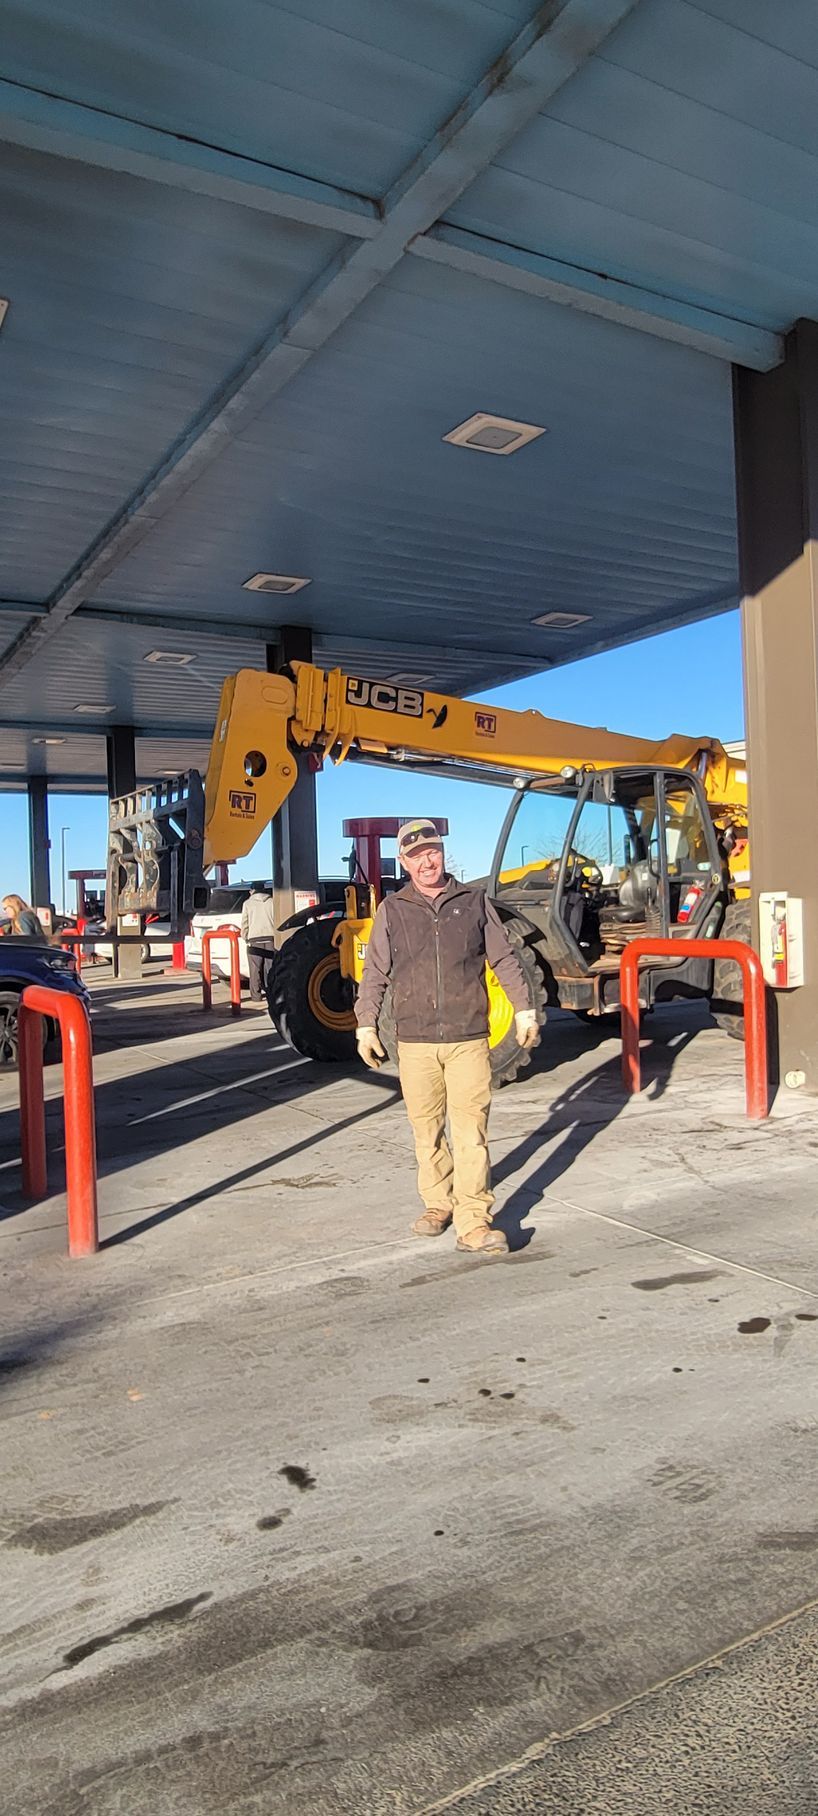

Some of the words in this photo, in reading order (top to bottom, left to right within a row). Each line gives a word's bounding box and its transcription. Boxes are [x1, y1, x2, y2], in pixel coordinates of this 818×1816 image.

[347, 678, 423, 716] JCB
[477, 715, 494, 730] RT
[231, 794, 254, 810] RT
